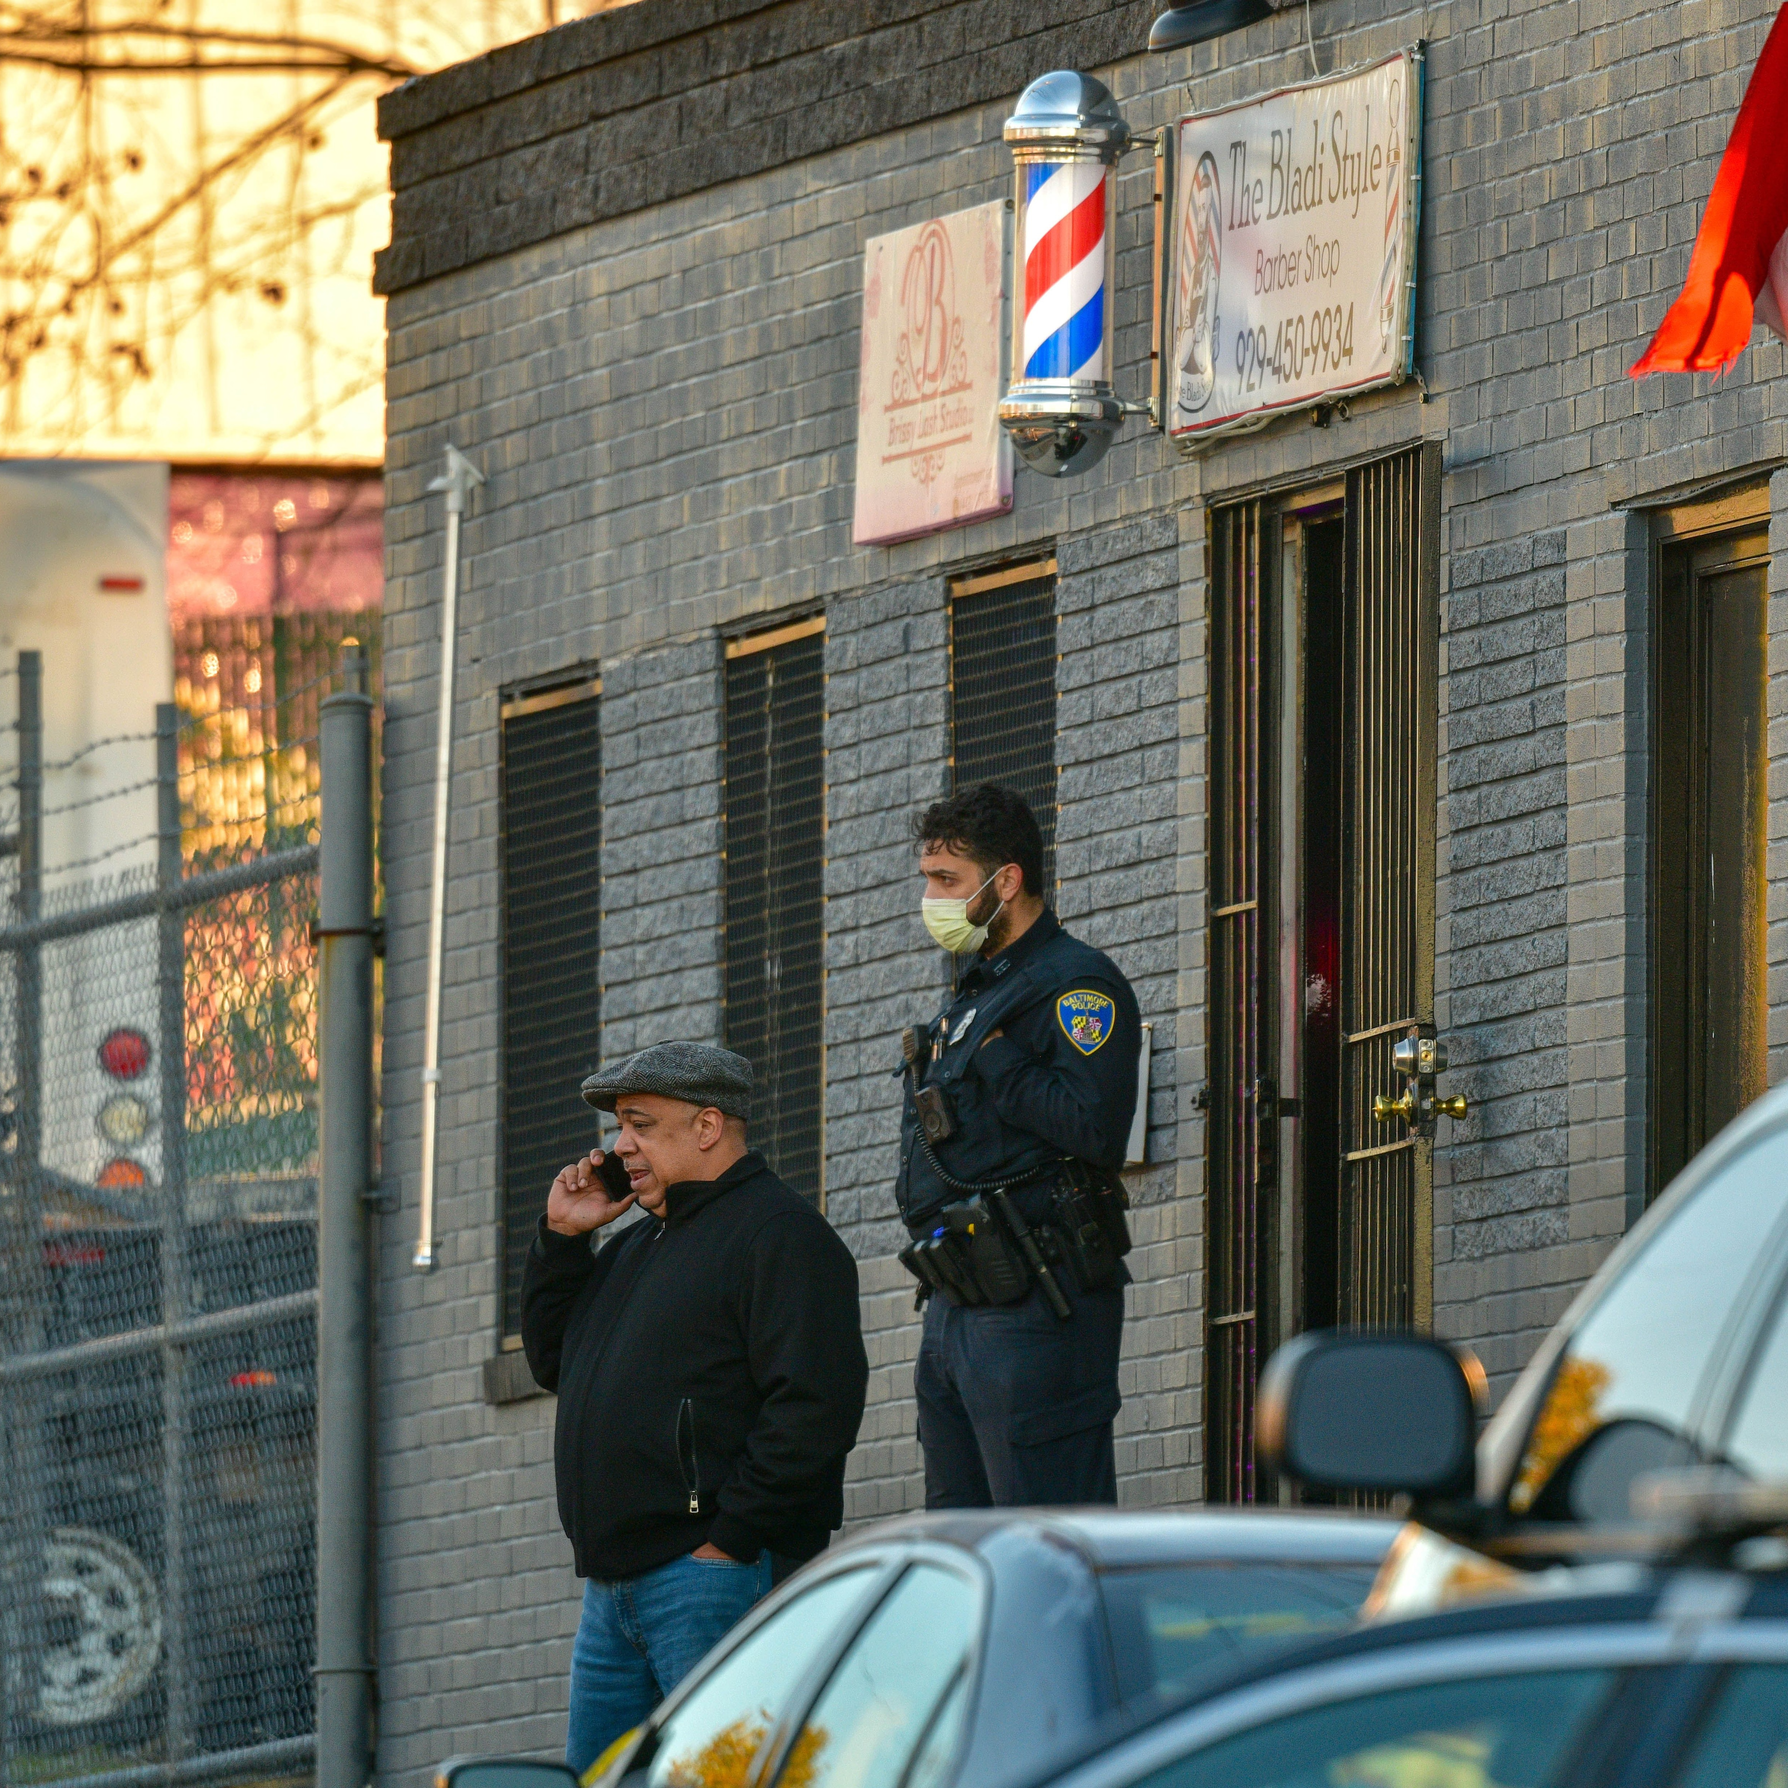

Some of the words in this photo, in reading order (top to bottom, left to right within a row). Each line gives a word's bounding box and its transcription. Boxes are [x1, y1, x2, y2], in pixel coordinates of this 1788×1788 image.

[1228, 139, 1264, 232] The
[1266, 119, 1325, 221] Bladi
[1328, 104, 1383, 220] Style
[1254, 243, 1303, 296] Barber
[1304, 233, 1341, 288] Shop
[1235, 301, 1354, 396] 929-450-9934
[1062, 994, 1109, 1008] BALTIMORE
[1071, 1002, 1101, 1012] POLICE
